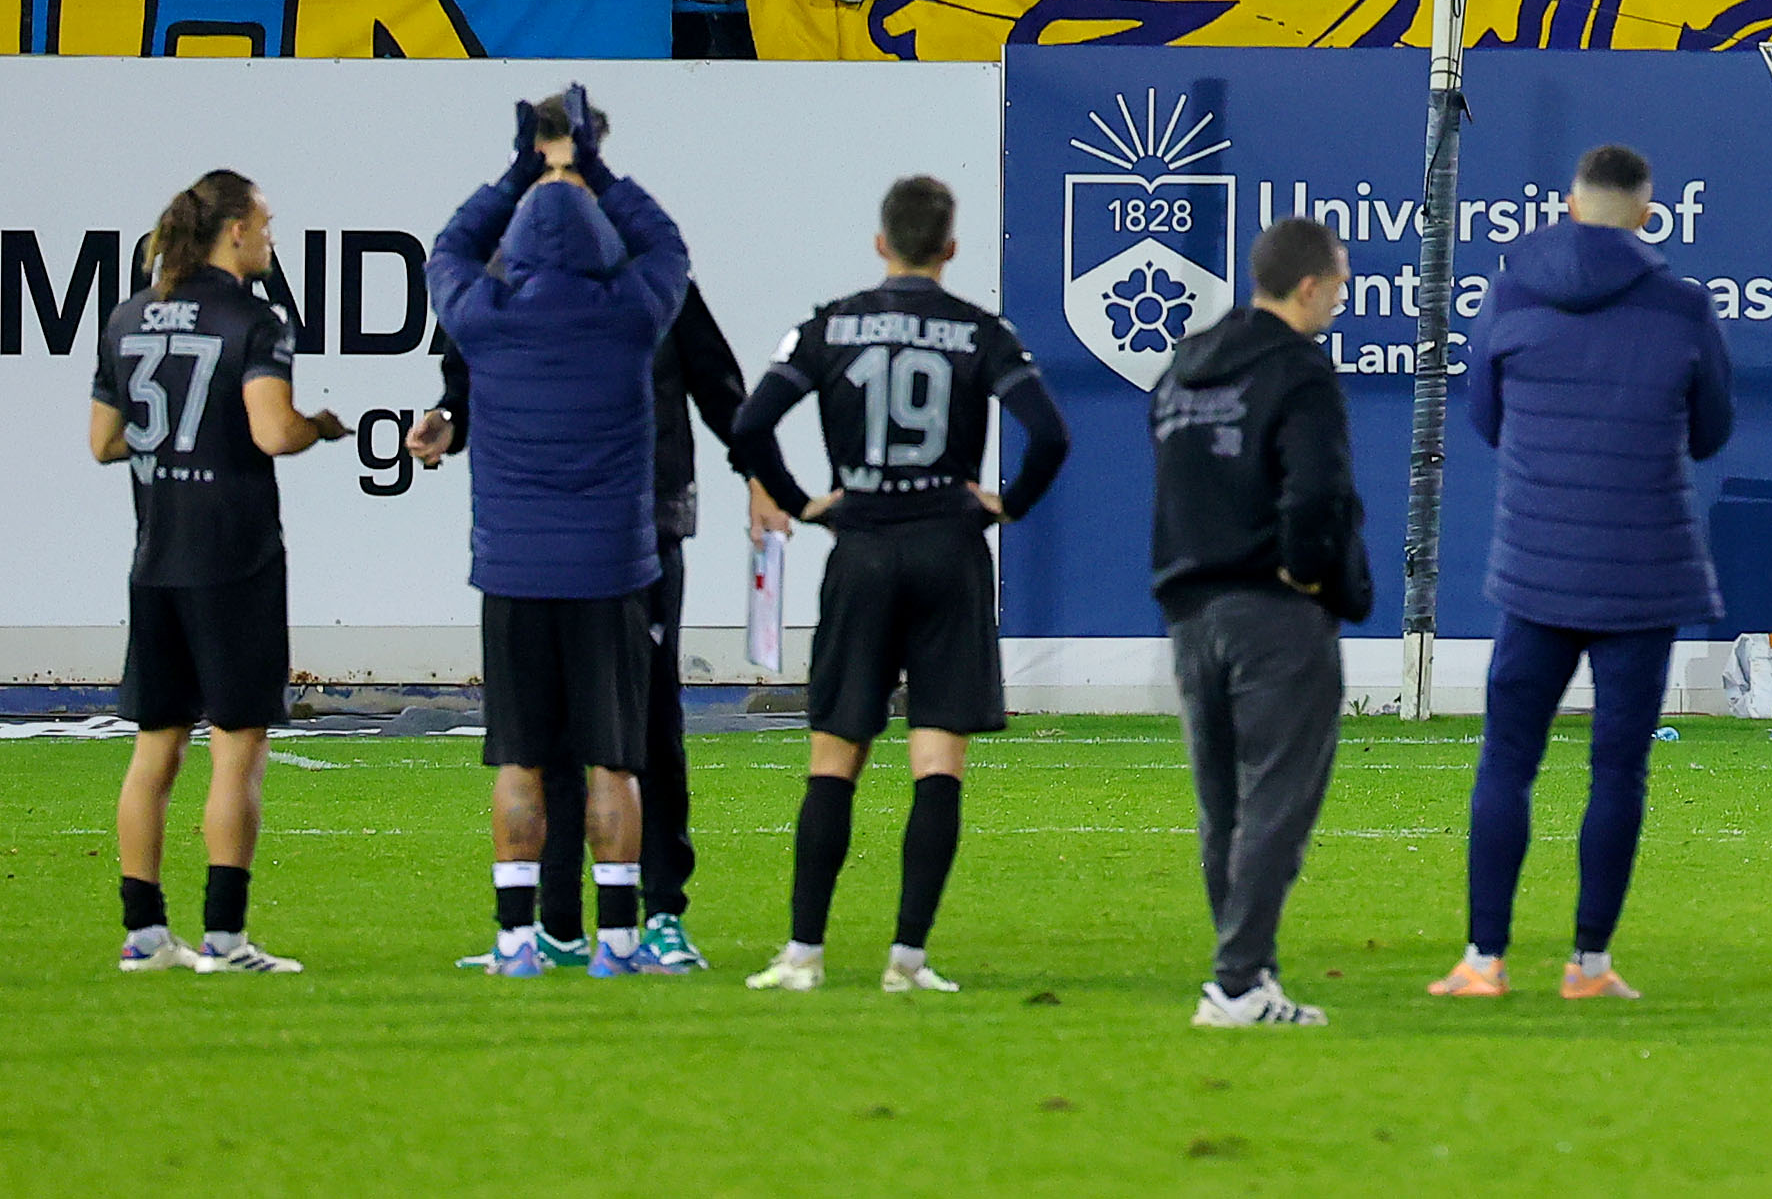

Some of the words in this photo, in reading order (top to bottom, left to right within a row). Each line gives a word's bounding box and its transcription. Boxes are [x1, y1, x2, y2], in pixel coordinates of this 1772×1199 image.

[1108, 199, 1192, 233] 1828
[1259, 180, 1570, 243] Univrsit
[1638, 181, 1705, 243] of
[119, 334, 224, 453] 37
[844, 344, 953, 468] 19
